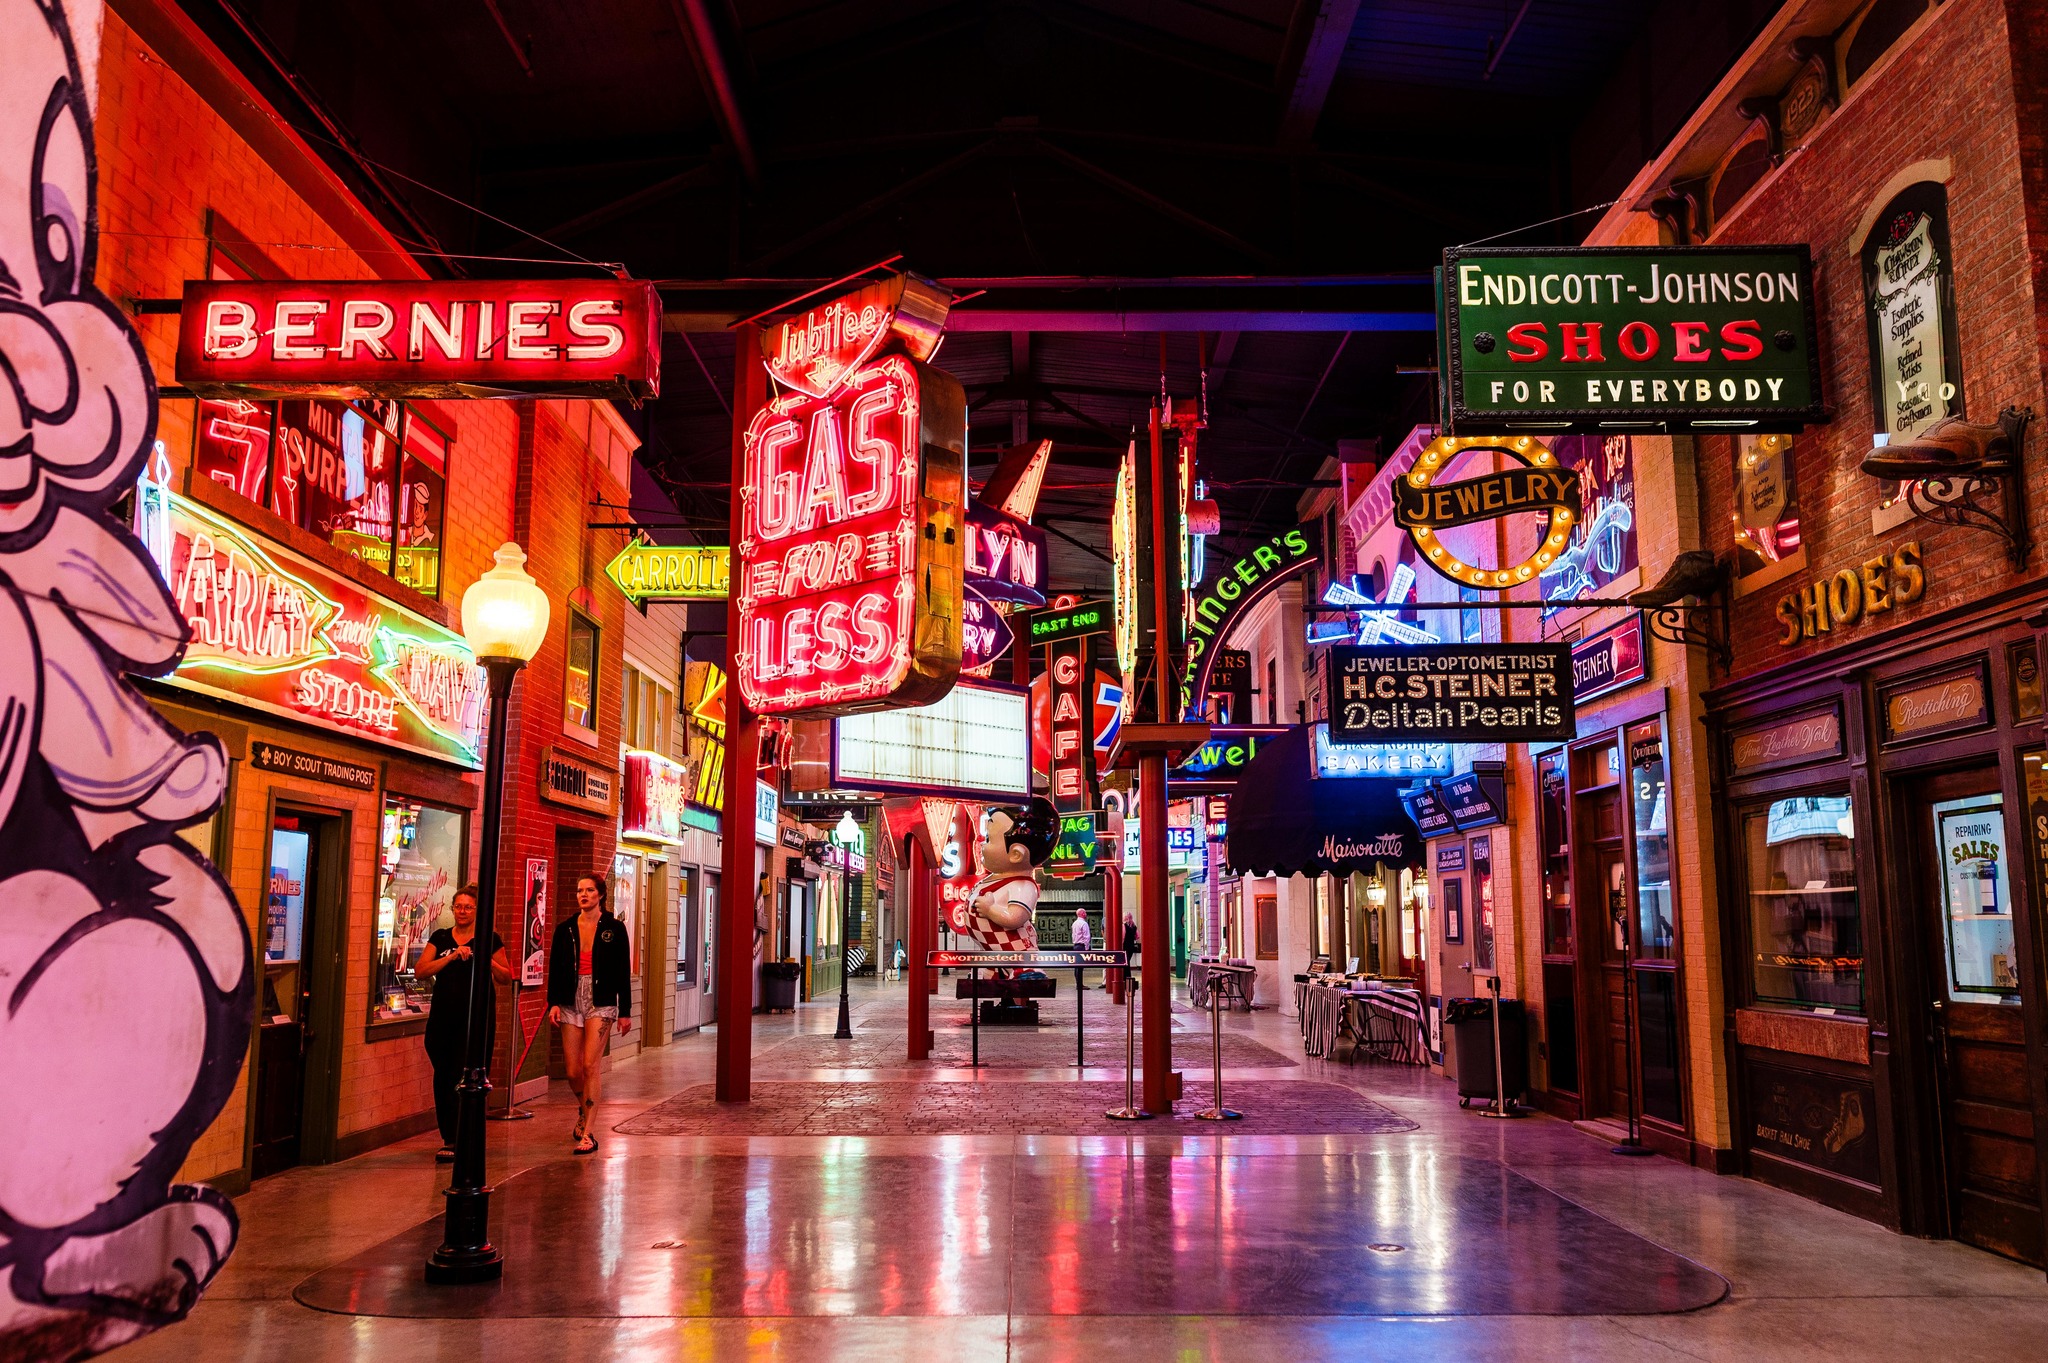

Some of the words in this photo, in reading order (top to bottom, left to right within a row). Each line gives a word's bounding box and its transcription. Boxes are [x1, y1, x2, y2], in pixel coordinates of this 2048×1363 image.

[1458, 263, 1800, 306] ENDICOTT-JOHNSON
[1890, 309, 1925, 342] Supplies
[1891, 294, 1923, 326] Esoteric
[203, 299, 624, 362] BERNIES
[772, 302, 878, 371] Jubilee
[1505, 318, 1765, 364] SHOES
[1901, 336, 1916, 349] FOR
[1896, 340, 1923, 371] Refined
[1900, 361, 1922, 384] Artists
[1490, 379, 1556, 404] FOR
[1587, 377, 1785, 403] EVERYBODY
[1896, 403, 1933, 433] Craftsmen
[756, 381, 900, 542] GAS
[1406, 474, 1577, 521] JEWELRY
[617, 553, 723, 590] CARROLL
[778, 531, 868, 597] FOR
[178, 530, 325, 660] ARMY
[1776, 541, 1927, 648] SHOES
[752, 592, 893, 681] LESS
[1031, 618, 1067, 635] EAST
[1072, 611, 1101, 627] END
[1344, 653, 1558, 674] JEWELER-OPTOMETRIST
[1573, 651, 1610, 690] STEINER
[297, 666, 400, 732] STORE
[1342, 673, 1559, 699] H.C.STEINER
[1342, 700, 1454, 730] Deltah
[1460, 700, 1562, 729] Pearls
[1895, 682, 1976, 727] Restiching
[1053, 654, 1081, 797] CAFE
[1738, 736, 1762, 764] Fine
[1762, 730, 1801, 758] Leather
[1799, 717, 1833, 751] Work
[273, 752, 292, 767] BOY
[294, 756, 321, 773] SCOUT
[324, 761, 355, 782] TRADING
[355, 767, 373, 785] POST
[1327, 754, 1444, 771] BAKERY
[1955, 822, 1992, 838] REPAIRING
[1317, 832, 1404, 864] Maisonette
[1473, 847, 1489, 861] CLEAN
[1951, 840, 2000, 866] SALES
[269, 878, 301, 897] RNIES
[939, 953, 1024, 963] Swormstedt
[1030, 952, 1076, 963] Family
[1079, 953, 1116, 964] Wing
[1756, 1123, 1778, 1141] BASKET
[1779, 1130, 1793, 1146] BALL
[1794, 1133, 1812, 1151] SHOE
